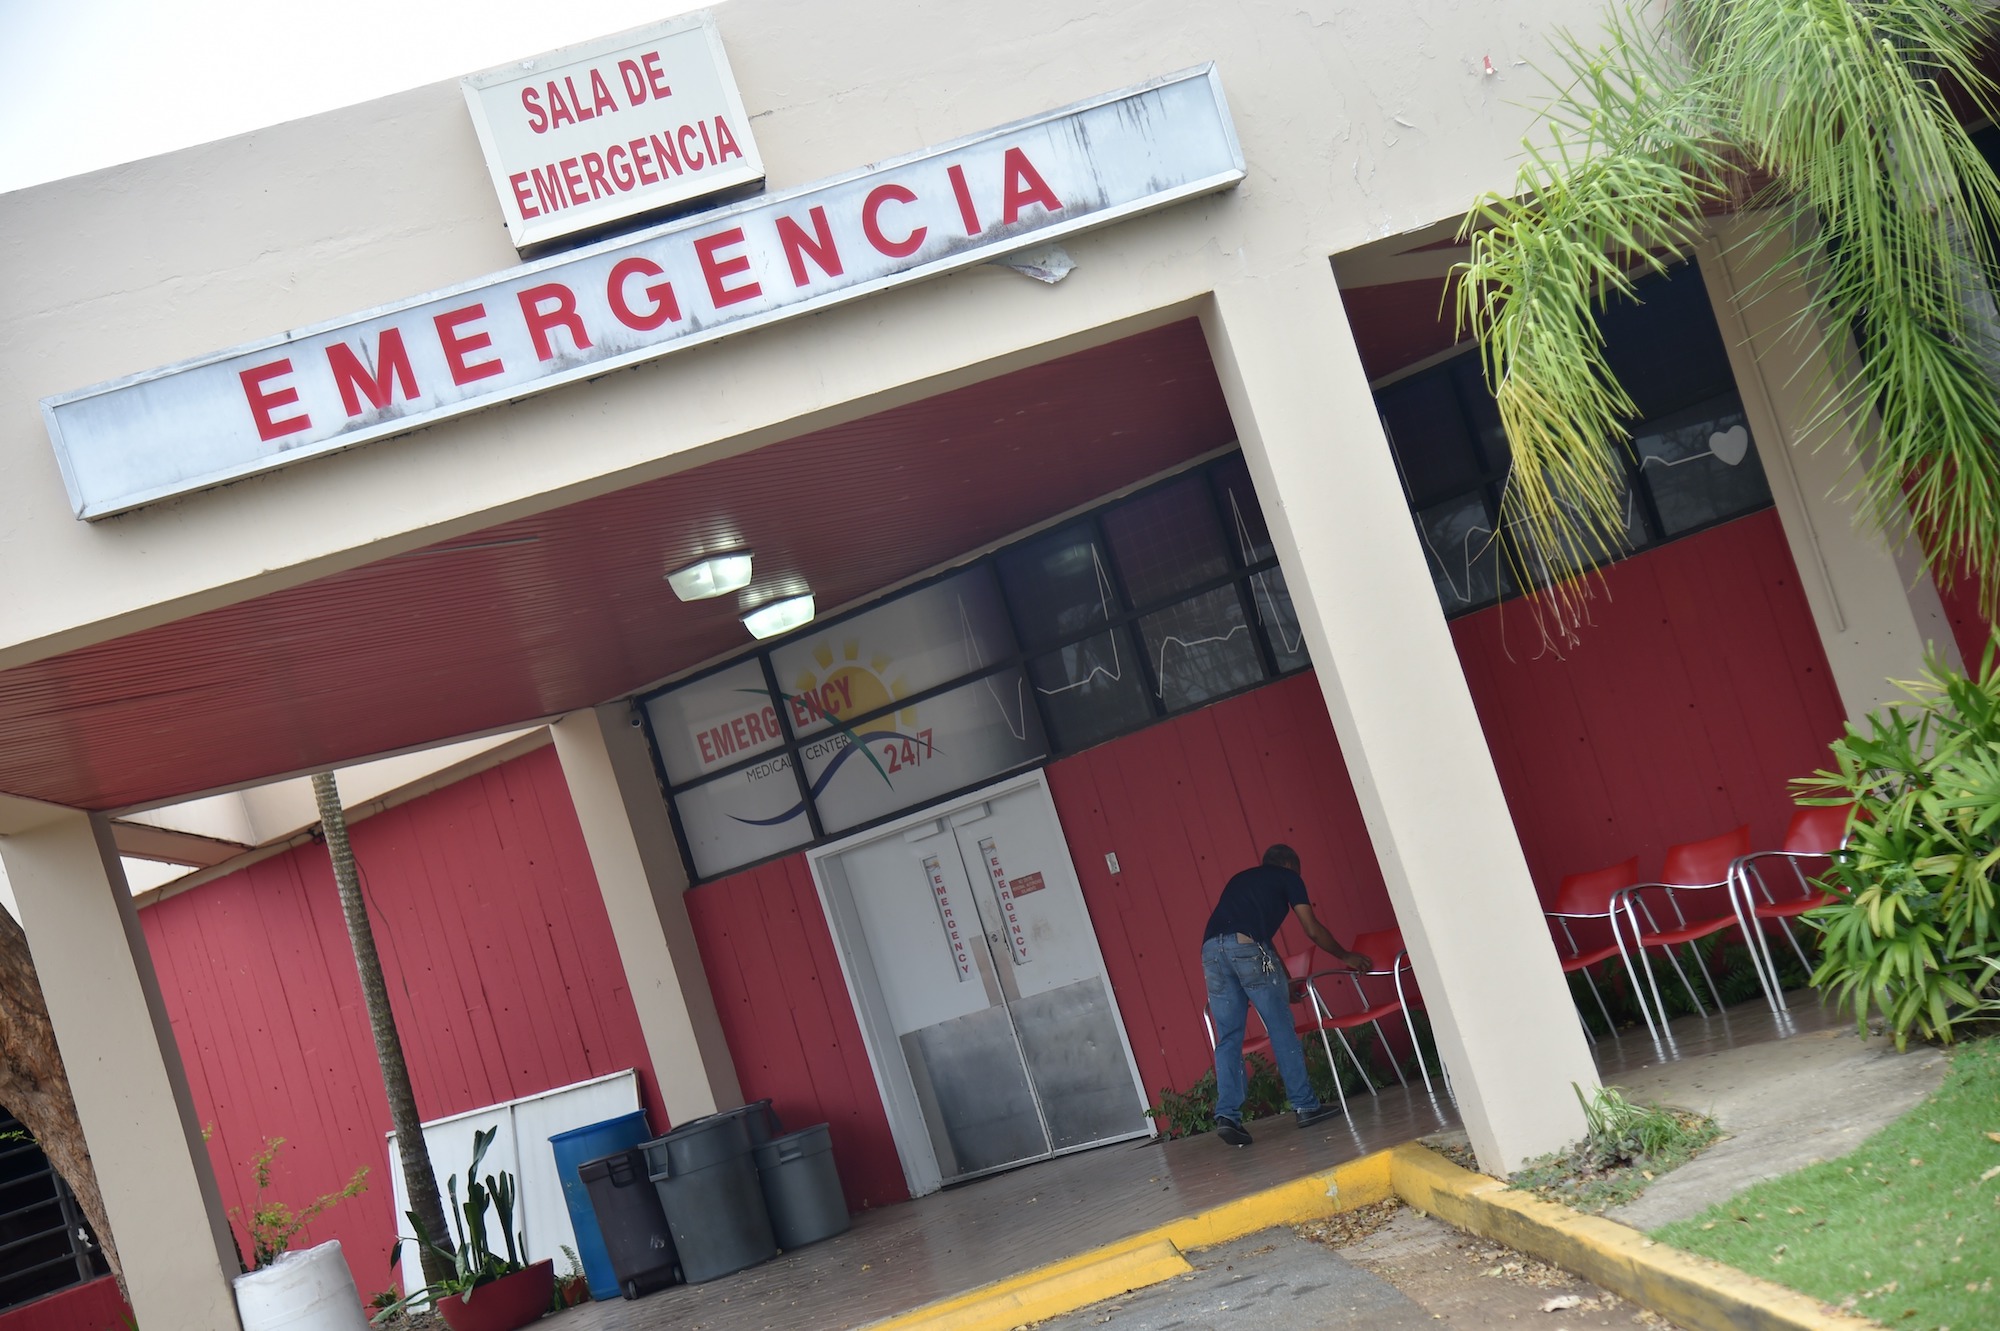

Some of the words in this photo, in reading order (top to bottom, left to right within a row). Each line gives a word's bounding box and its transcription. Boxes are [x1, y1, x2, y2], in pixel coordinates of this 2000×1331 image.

[521, 68, 619, 134] SALA
[617, 51, 673, 107] DE
[509, 115, 743, 220] EMERGENCIA
[239, 146, 1063, 442] EMERGENCIA
[696, 675, 853, 764] EMERGENCY
[746, 755, 793, 783] MEDICAL
[805, 734, 850, 761] CENTER
[883, 727, 933, 774] 24/7
[934, 875, 969, 974] EMERGENCY
[990, 857, 1027, 957] EMERGENCY
